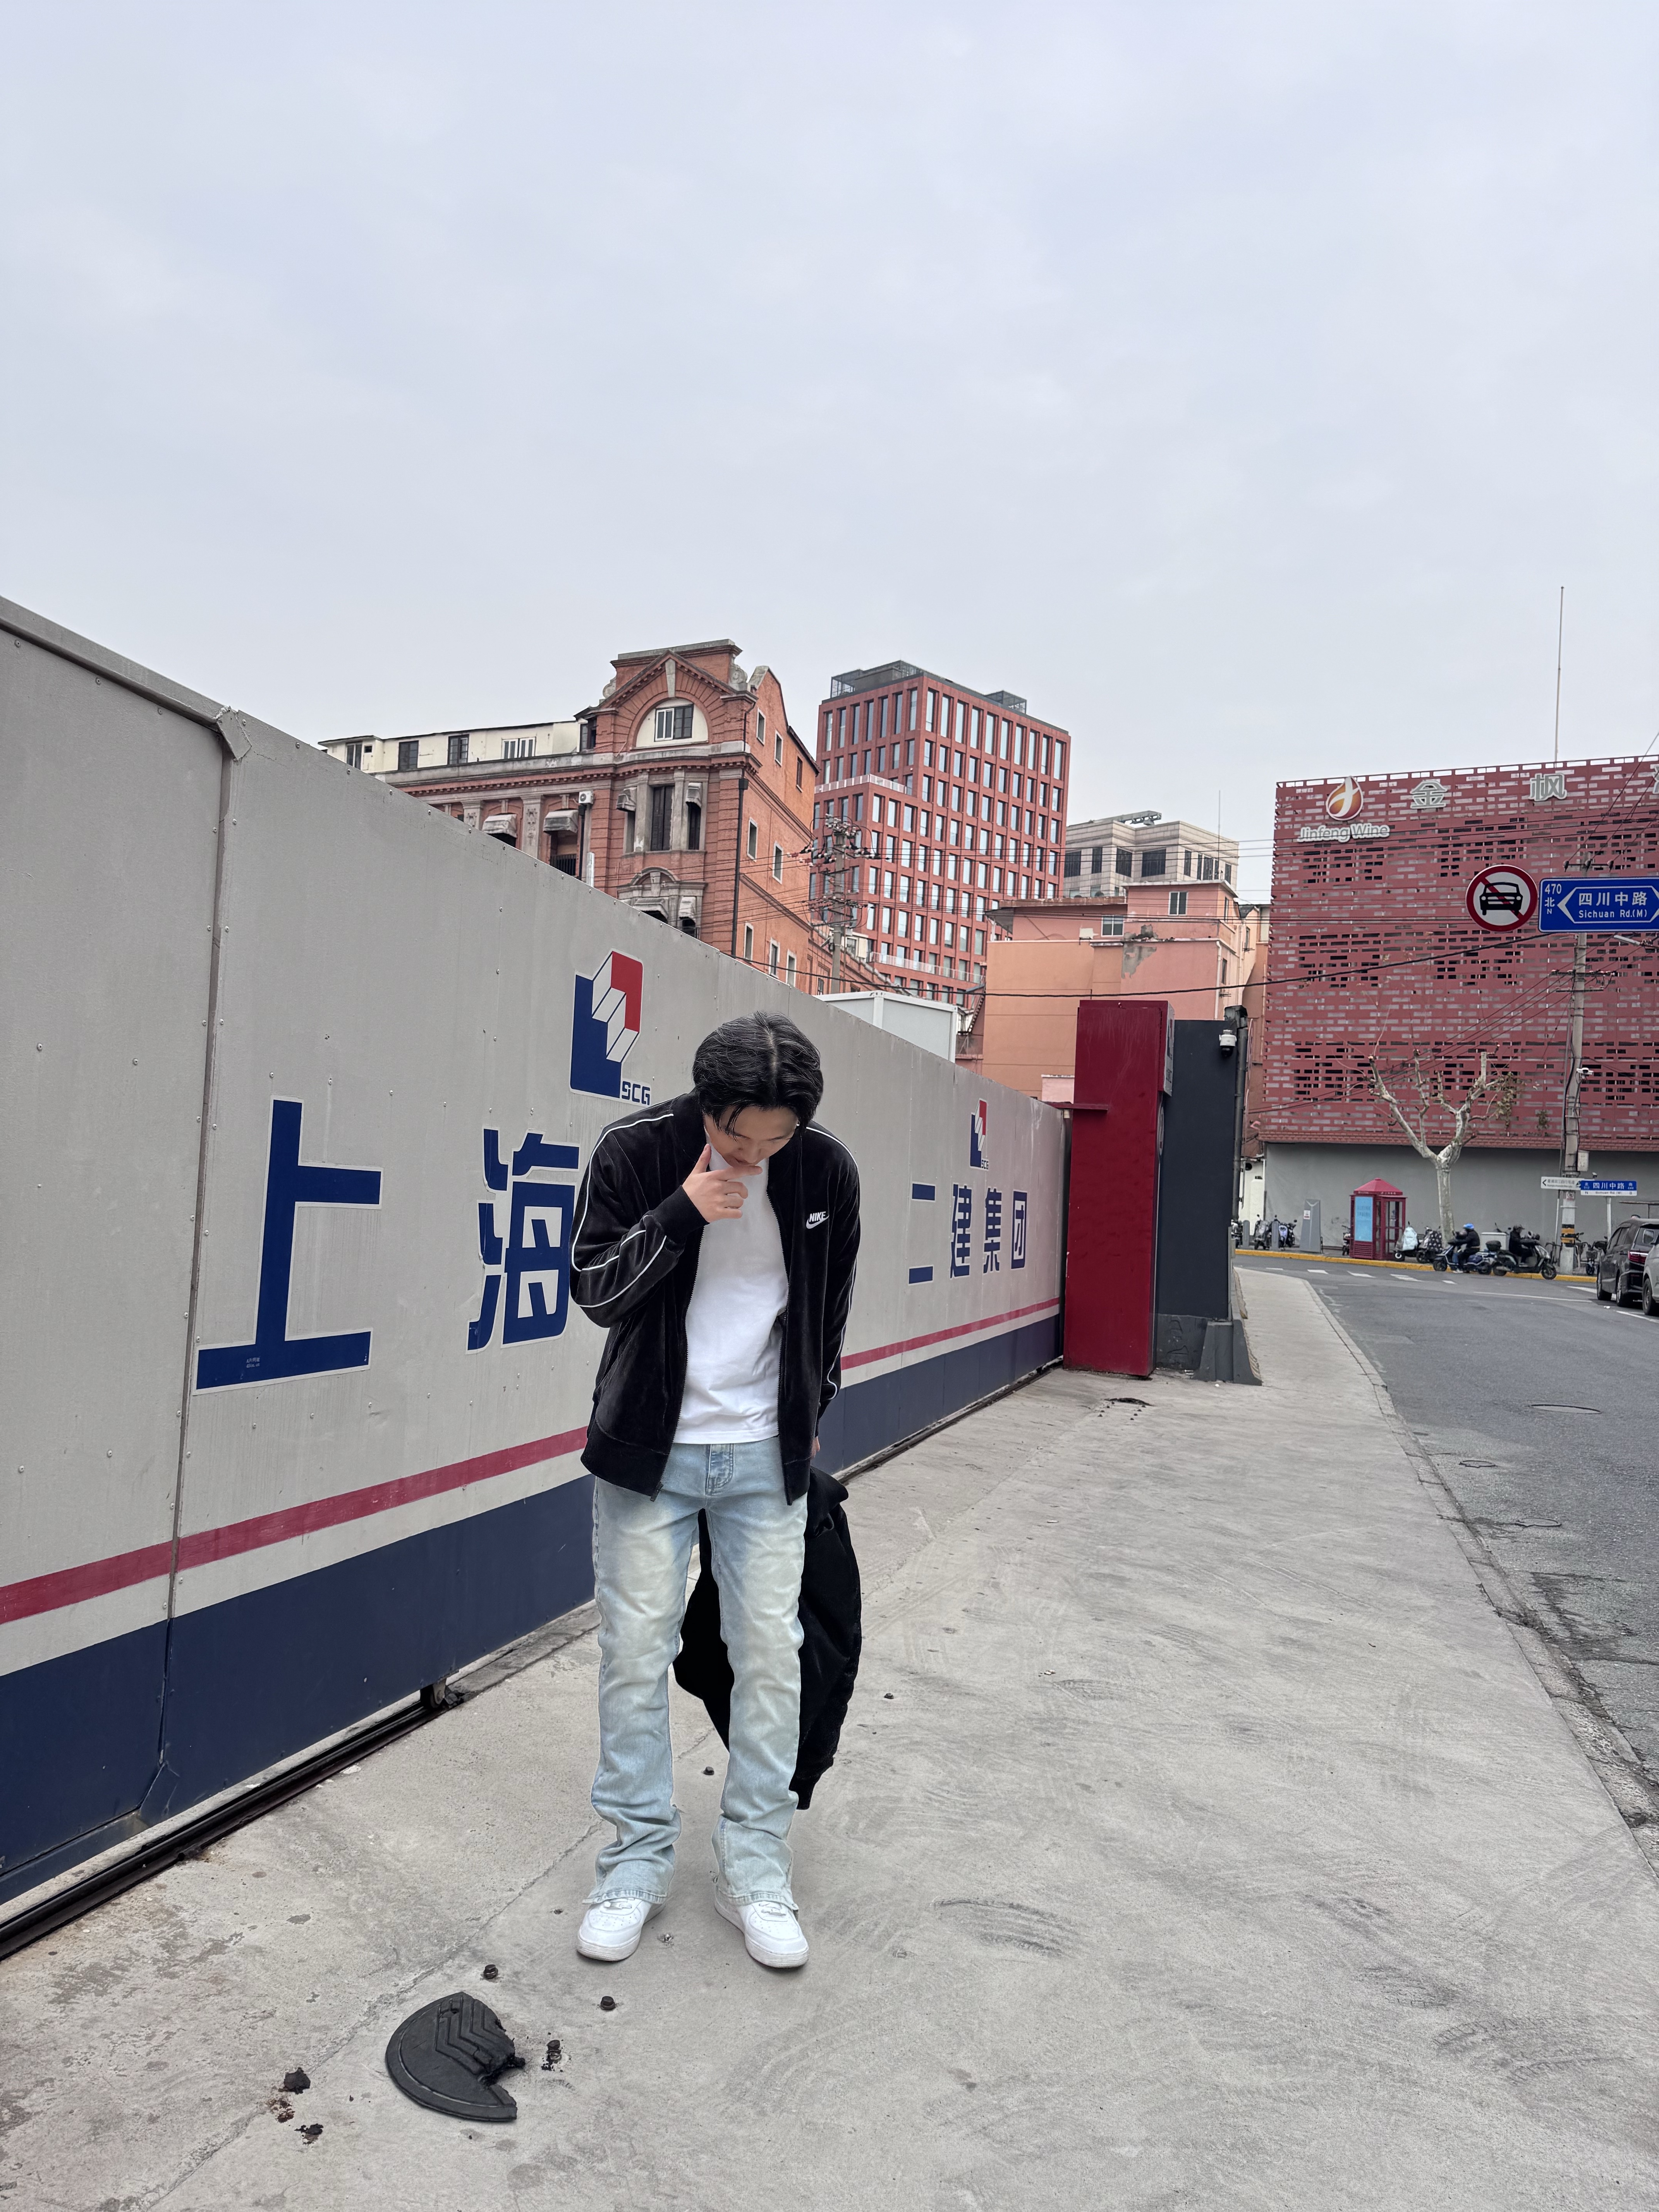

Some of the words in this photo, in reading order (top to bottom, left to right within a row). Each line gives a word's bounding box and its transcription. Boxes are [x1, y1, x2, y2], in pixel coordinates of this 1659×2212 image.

[1410, 764, 1659, 809] 金枫
[1297, 825, 1350, 842] Jinfeng
[1351, 823, 1389, 838] Wine
[1545, 884, 1561, 894] 470
[1579, 891, 1647, 906] 四川中路
[1544, 897, 1555, 907] 北
[622, 1081, 650, 1105] SCG
[809, 1211, 826, 1222] NIKE
[908, 1183, 1027, 1284] 二建集团
[196, 1099, 580, 1389] 上海
